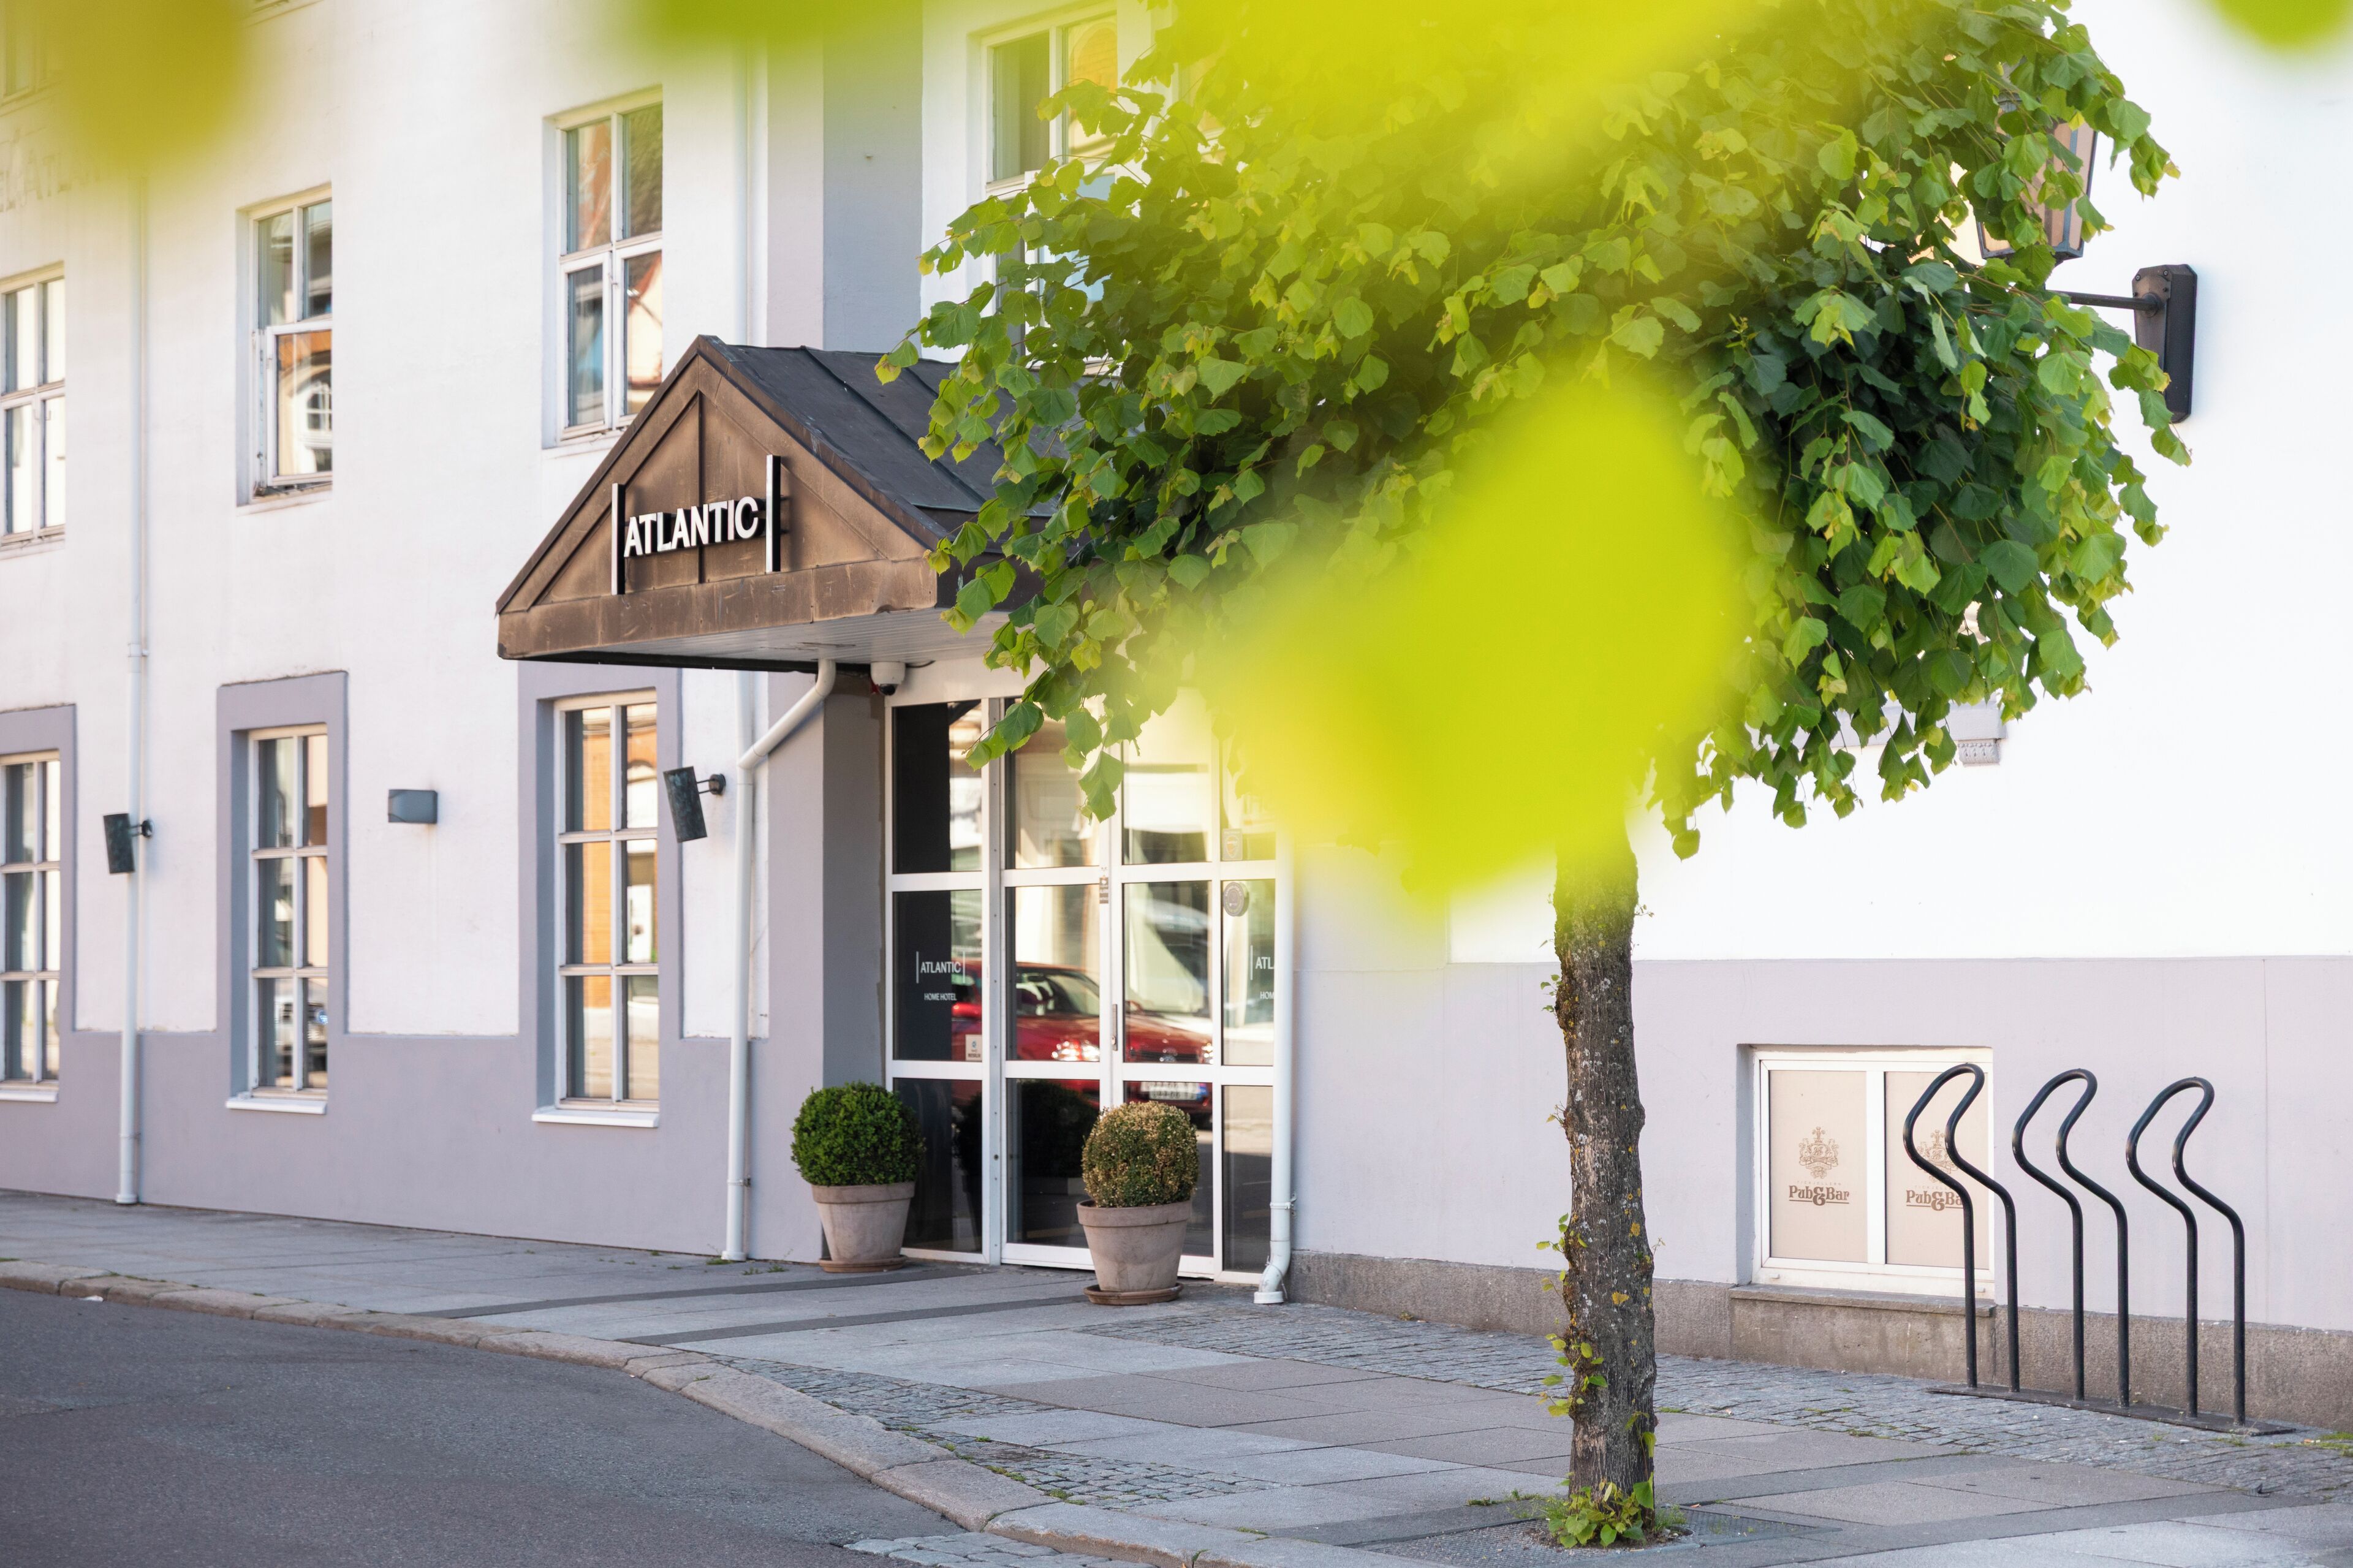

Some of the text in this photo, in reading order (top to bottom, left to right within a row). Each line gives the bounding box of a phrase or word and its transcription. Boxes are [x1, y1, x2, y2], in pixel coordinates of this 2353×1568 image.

[623, 496, 759, 558] ATLANTIC
[920, 961, 961, 973] ATLANTIC
[1256, 956, 1275, 970] ATL
[1906, 1190, 1963, 1211] Pub&Ba
